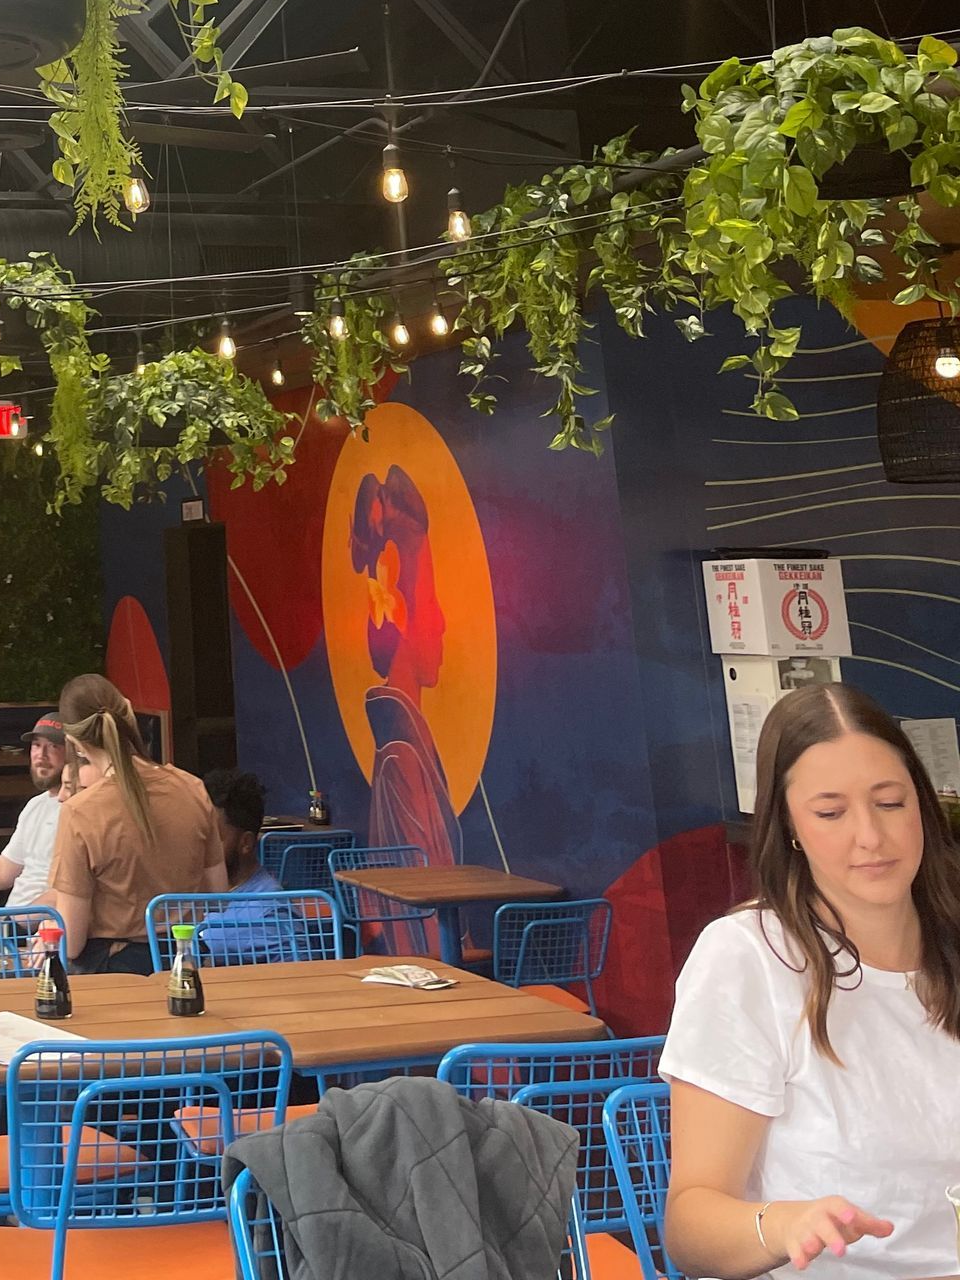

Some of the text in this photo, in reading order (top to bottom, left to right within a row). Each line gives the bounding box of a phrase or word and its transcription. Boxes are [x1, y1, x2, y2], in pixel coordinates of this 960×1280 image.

[773, 563, 785, 571] THE
[809, 564, 825, 572] SAKE
[778, 571, 823, 580] GEKKEIKAN
